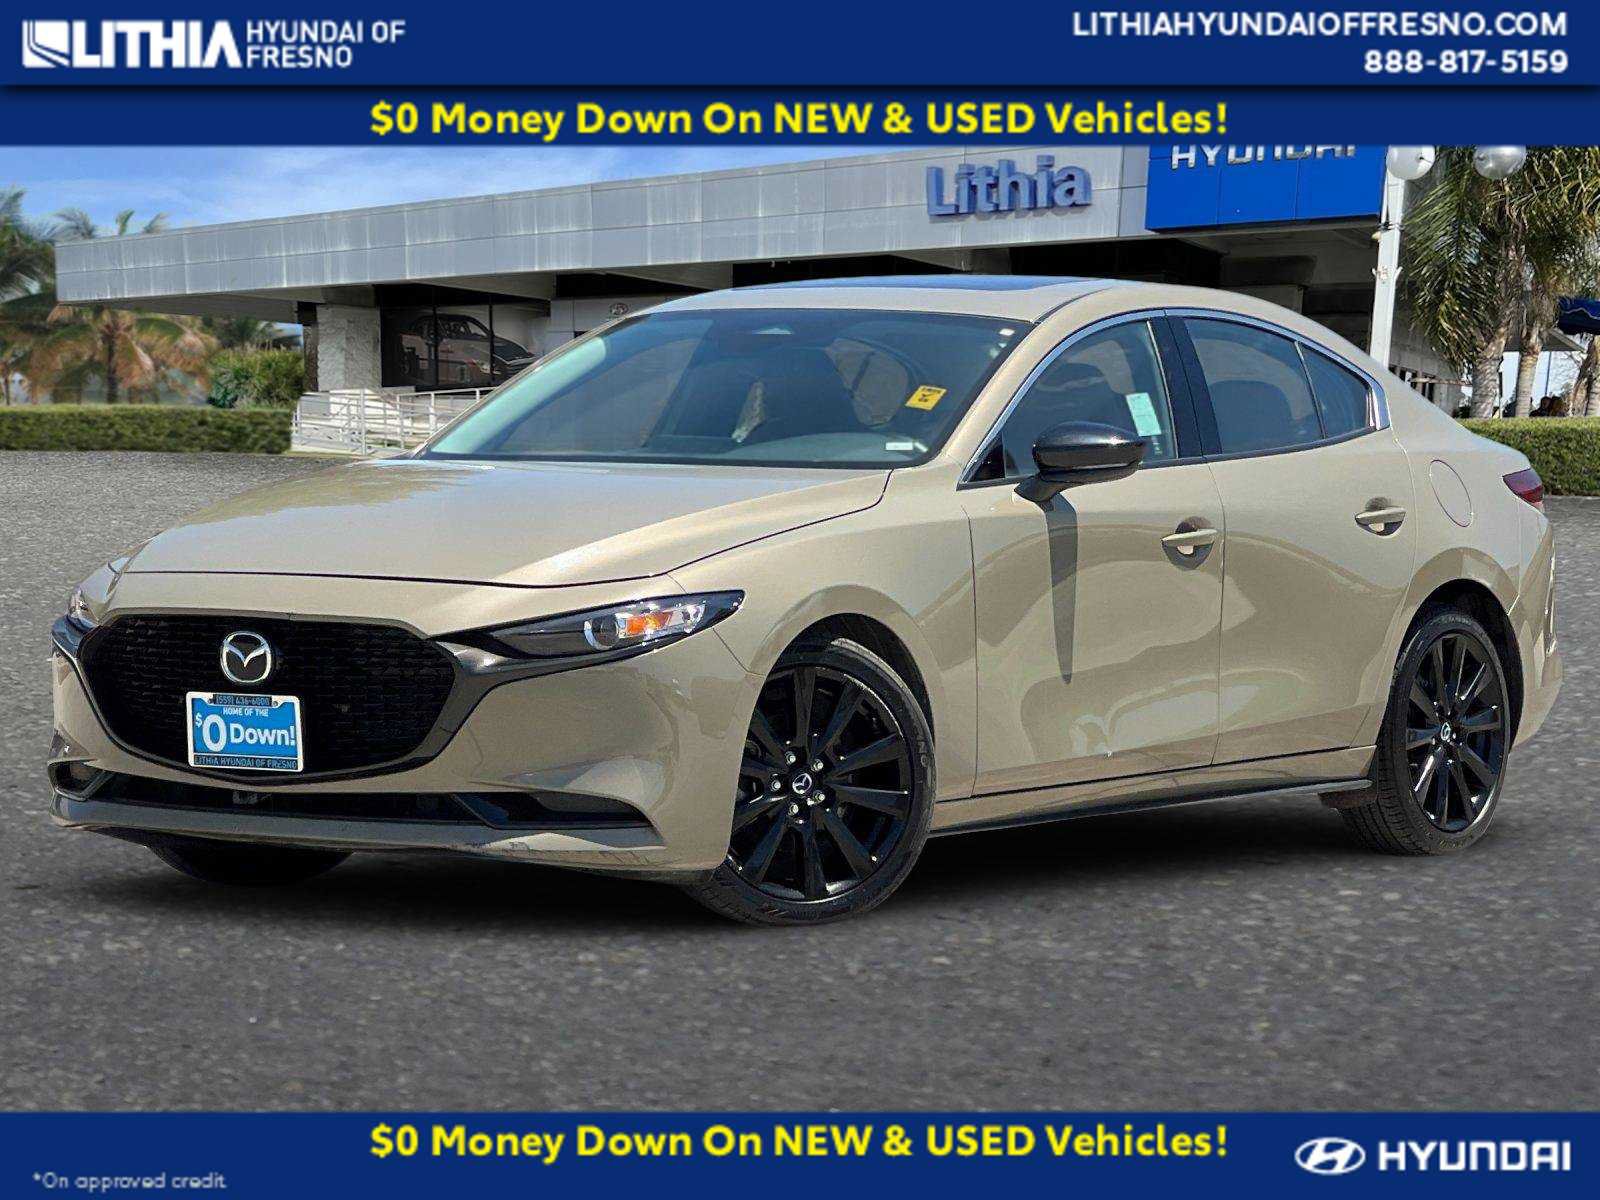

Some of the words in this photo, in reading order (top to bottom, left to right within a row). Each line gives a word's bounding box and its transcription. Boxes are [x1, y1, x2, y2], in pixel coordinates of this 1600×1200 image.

[926, 154, 1093, 217] Lithia
[222, 707, 243, 716] HOME
[244, 708, 254, 716] OF
[255, 708, 269, 717] THE
[229, 723, 296, 747] Down!
[194, 755, 219, 765] LITHIA
[220, 757, 255, 768] HYUNDAI
[255, 759, 266, 769] OF
[267, 760, 297, 770] FRESNO
